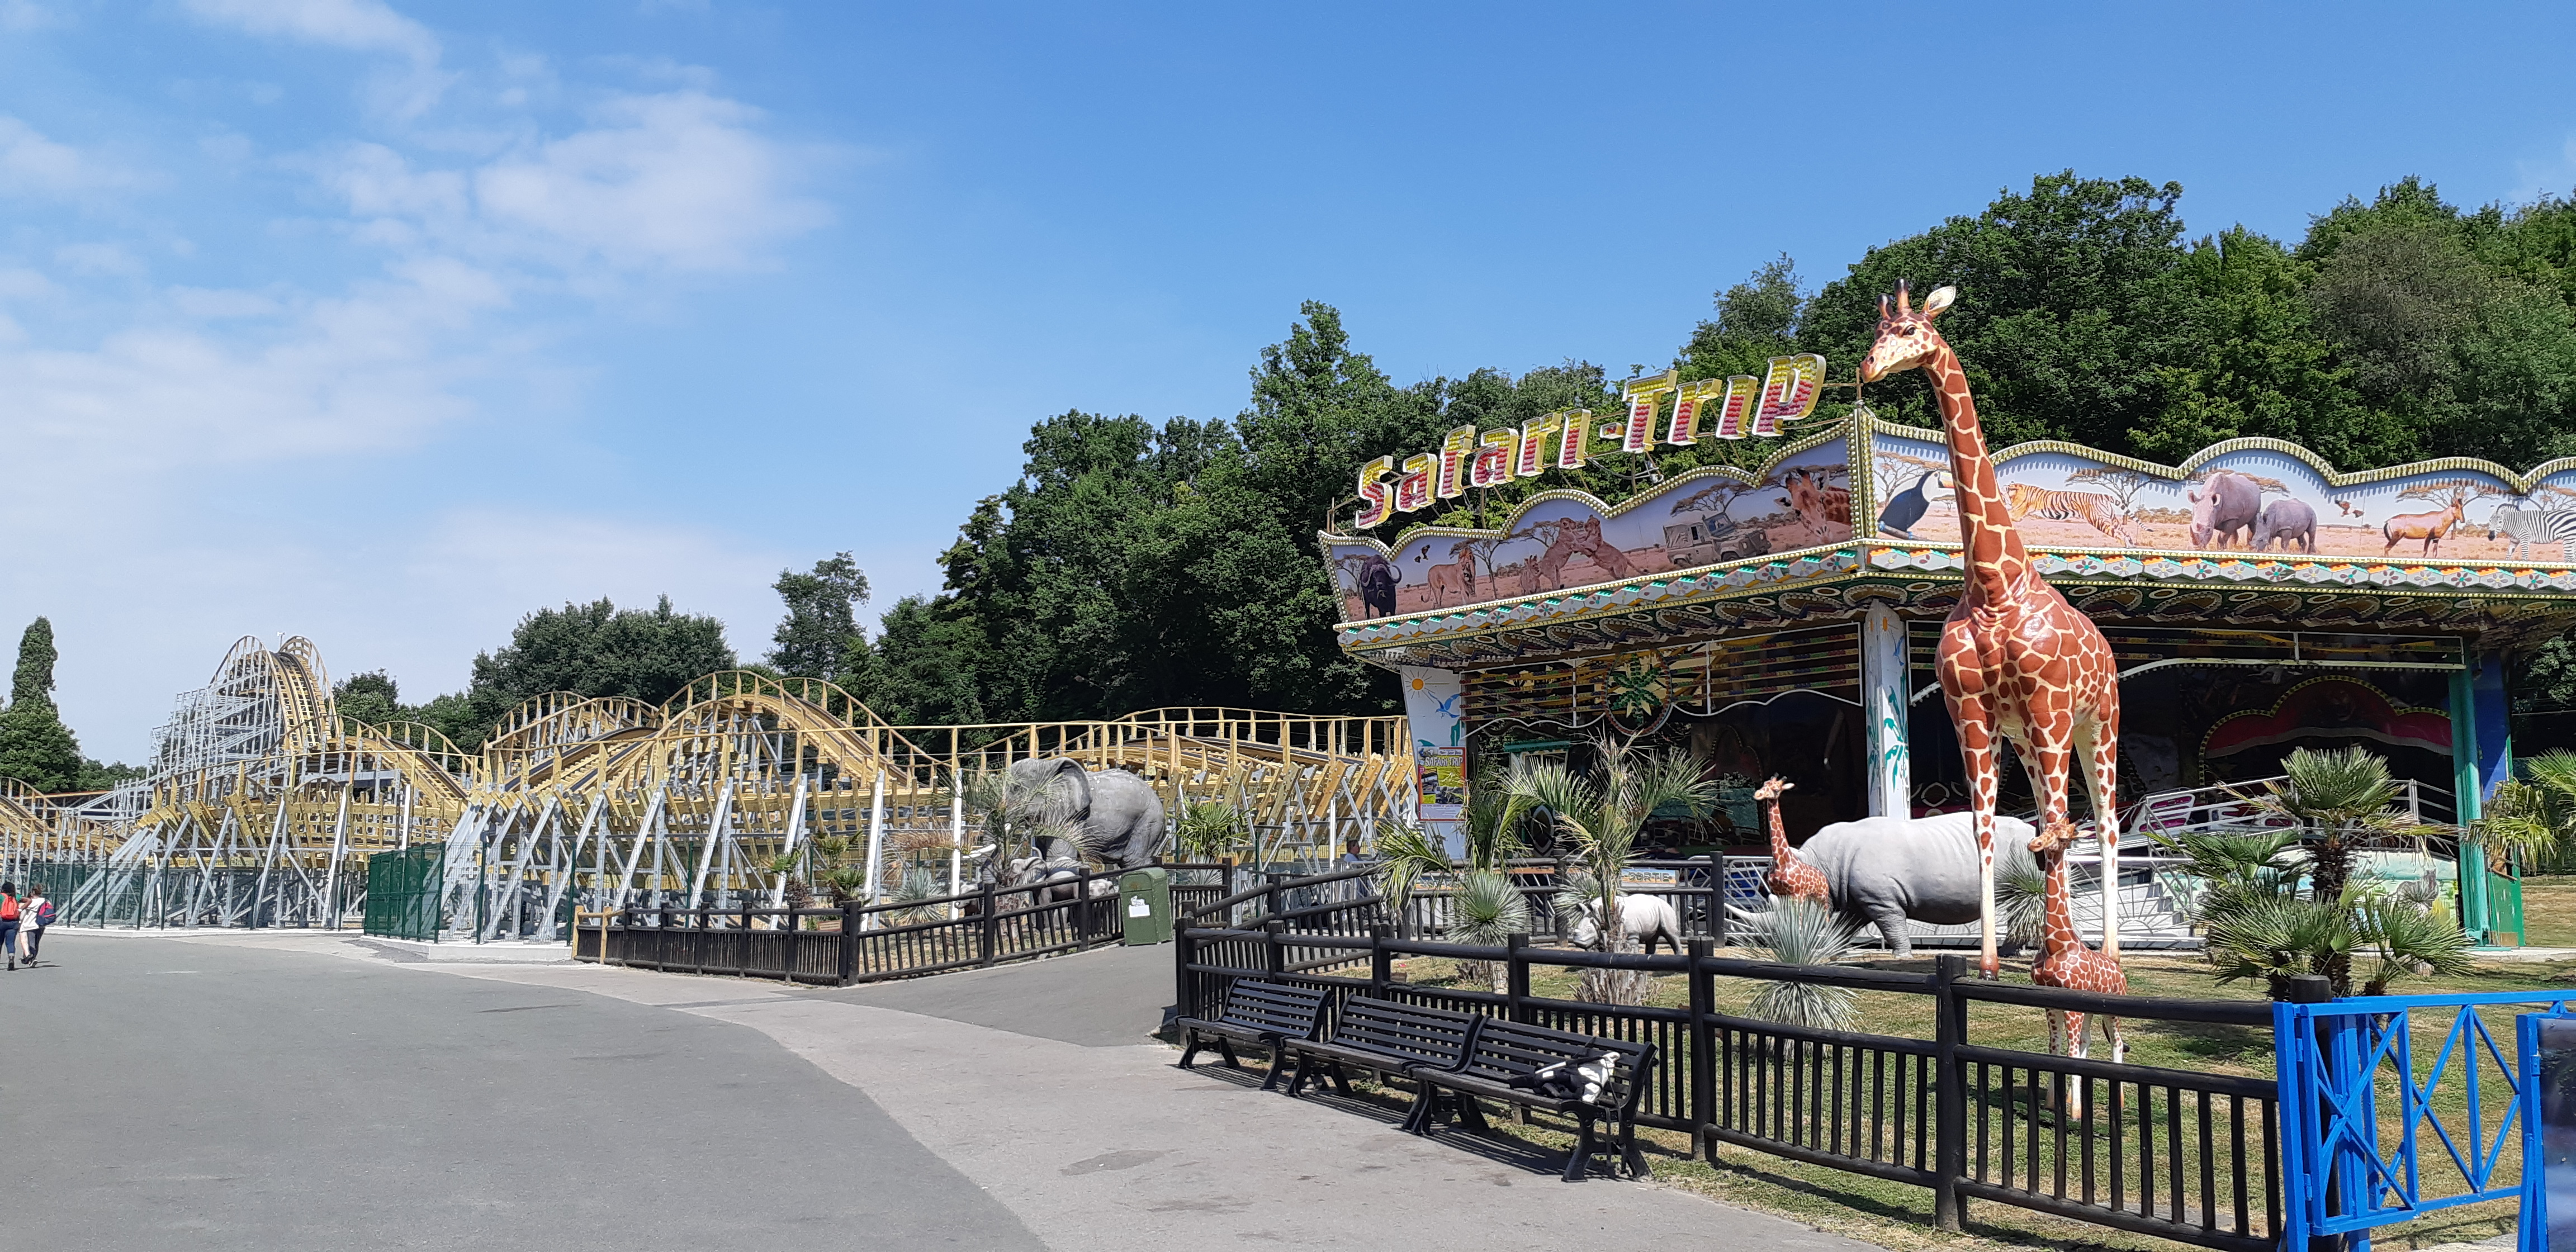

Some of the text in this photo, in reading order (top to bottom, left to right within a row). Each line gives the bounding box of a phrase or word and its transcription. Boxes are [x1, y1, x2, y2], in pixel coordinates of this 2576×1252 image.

[1425, 756, 1463, 766] SAFARI TRIP
[1628, 871, 1670, 882] SORTIE
